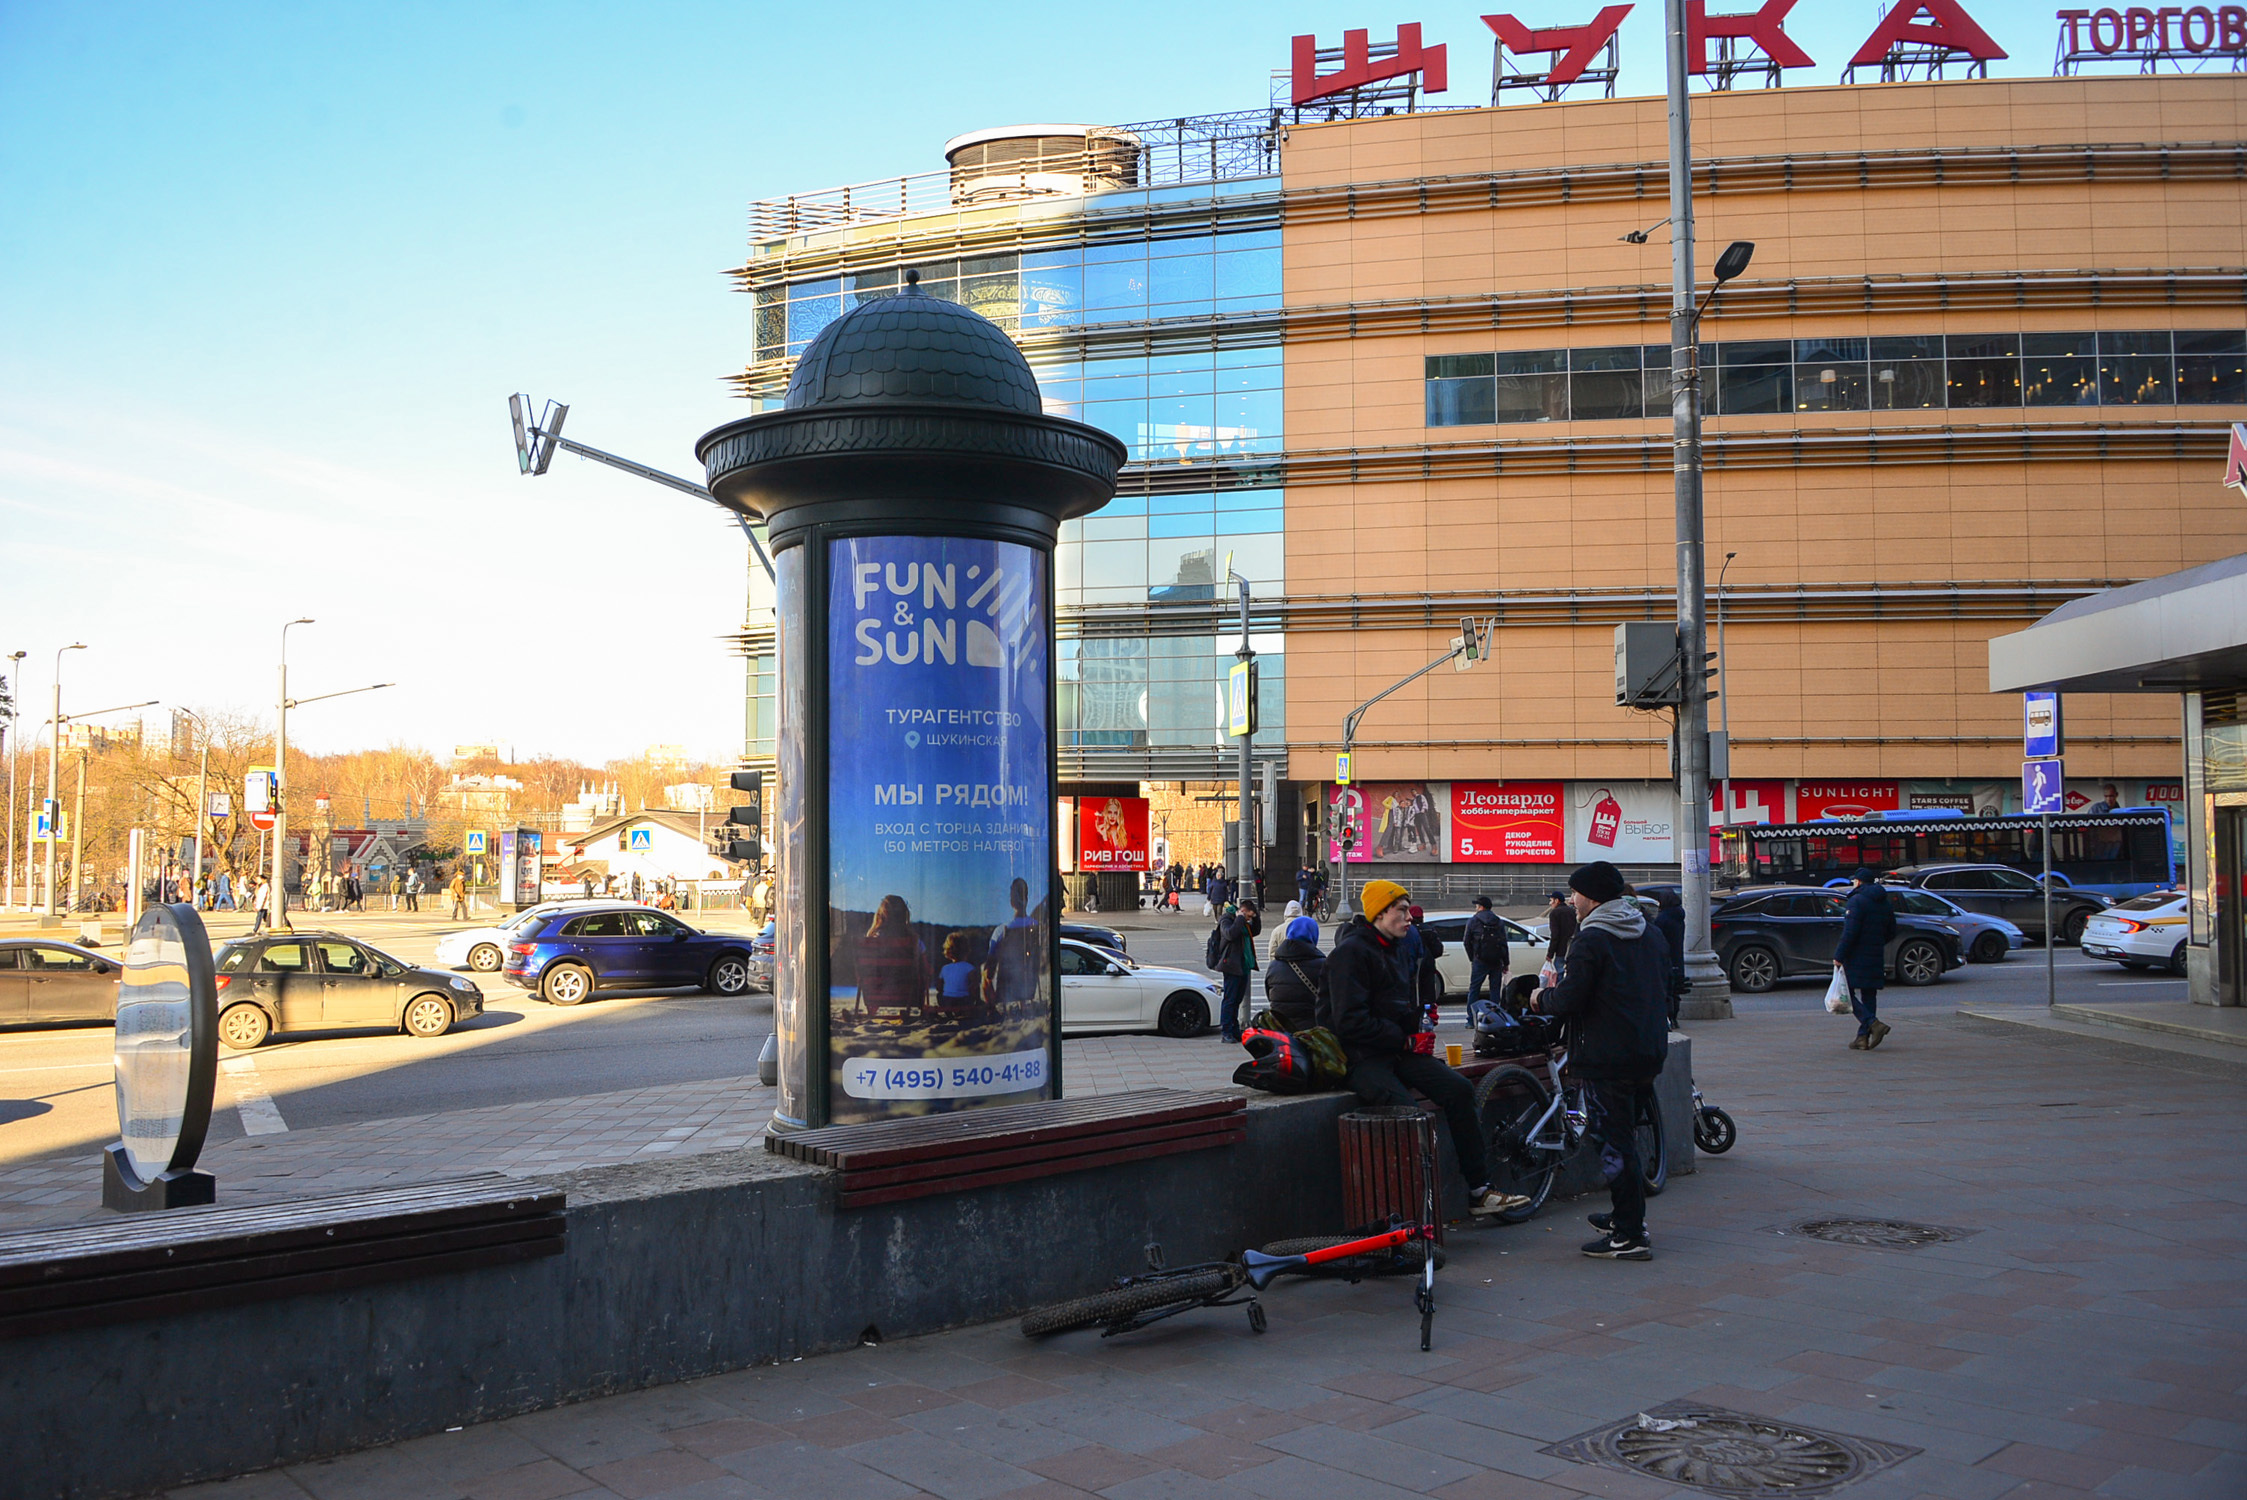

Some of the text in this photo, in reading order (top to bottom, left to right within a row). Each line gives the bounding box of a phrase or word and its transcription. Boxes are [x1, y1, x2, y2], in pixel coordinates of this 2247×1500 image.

[2056, 6, 2247, 55] ТОРГОВ
[1292, 0, 2009, 106] ЩУКА
[855, 562, 956, 611] FUN
[893, 601, 914, 626] &
[855, 617, 956, 666] SUN
[885, 709, 1021, 727] ТУРАГЕНТСТВО
[927, 733, 1007, 746] ЩУКИНСКАЯ
[874, 784, 1028, 808] МЫ РЯДОМ!
[1460, 791, 1555, 808] Леонардо
[1801, 787, 1894, 798] SUNLIGHT
[1461, 807, 1555, 816] хобби-гипермаркет
[875, 823, 915, 836] ВХОД
[920, 823, 930, 835] С
[935, 823, 982, 836] ТОРЦА
[1625, 823, 1670, 835] ВЫБОР
[884, 840, 1024, 852] (50 МЕТРОВ НАЛЕВО)
[1461, 838, 1474, 855] 5
[1084, 850, 1144, 862] РИВ ГОШ
[856, 1060, 1040, 1090] +7 (495) 540-41-88
